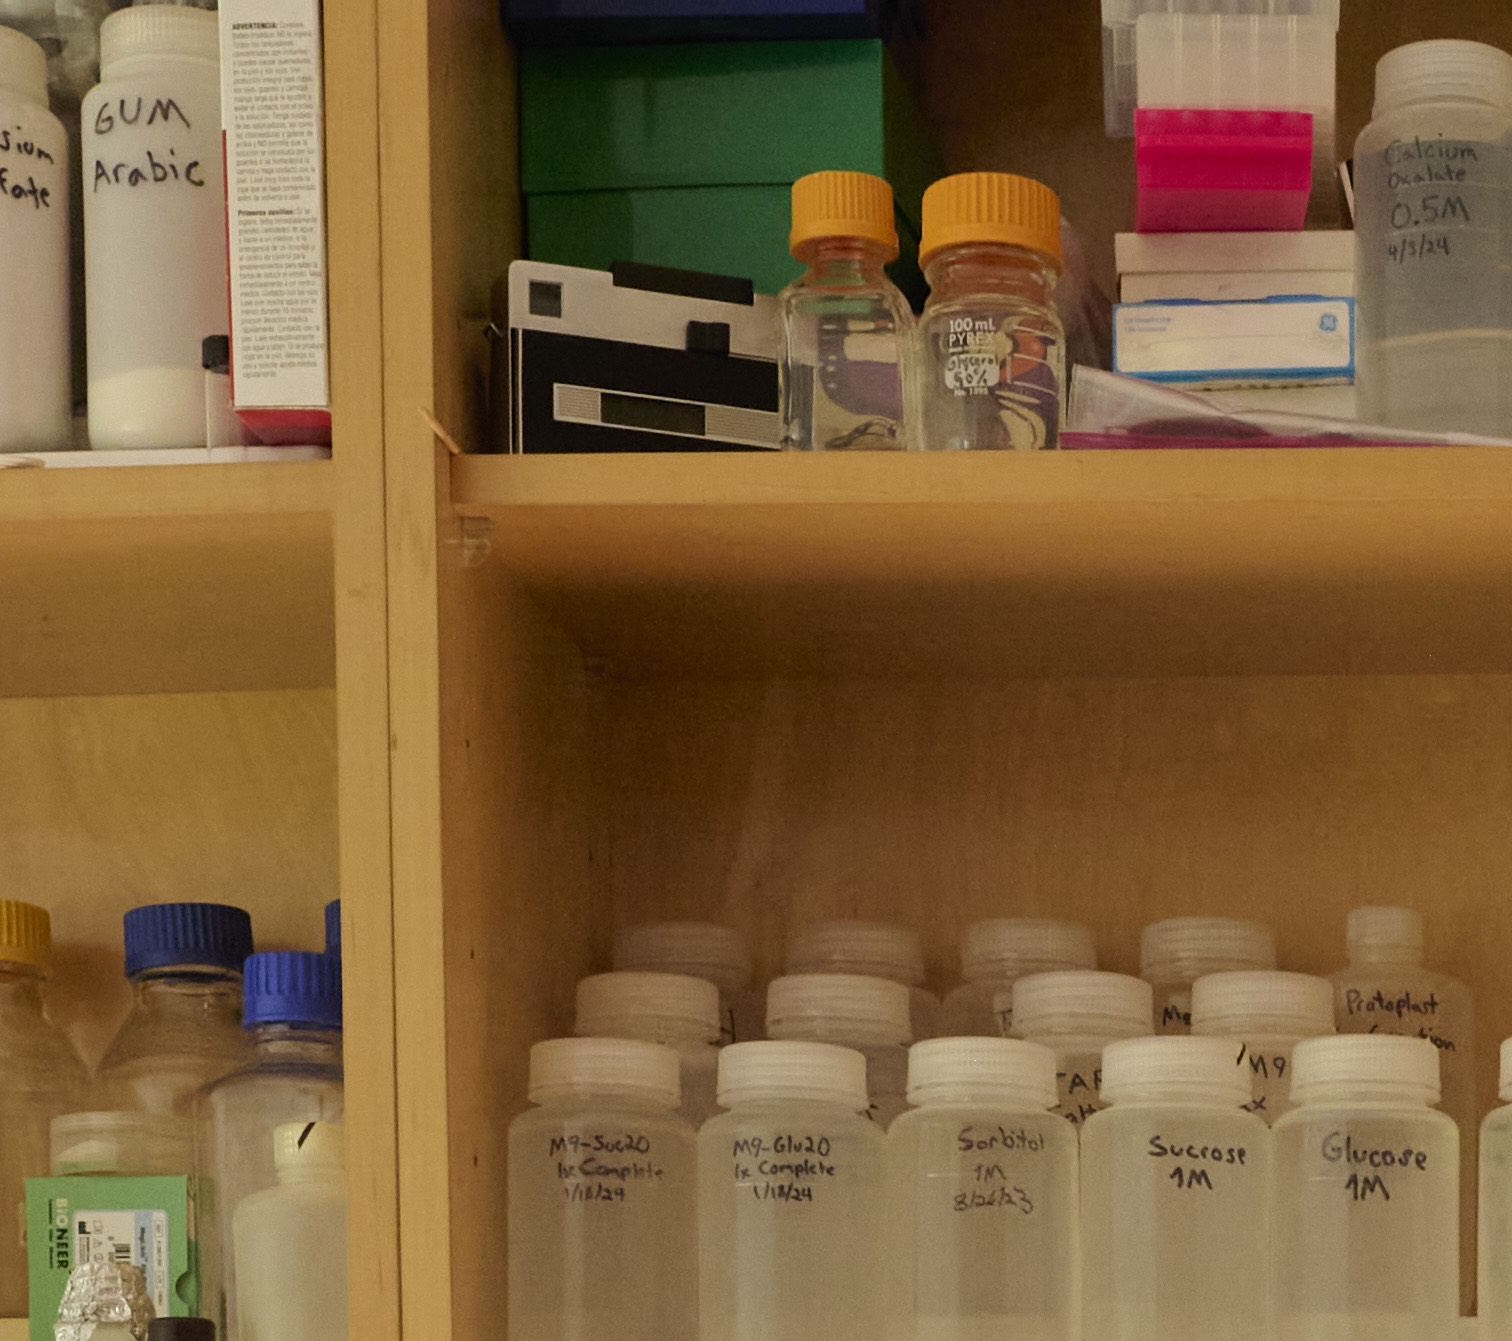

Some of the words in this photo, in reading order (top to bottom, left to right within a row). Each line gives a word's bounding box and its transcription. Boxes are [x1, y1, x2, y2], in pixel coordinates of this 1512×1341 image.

[94, 99, 191, 137] GUM
[1385, 134, 1478, 166] Calcium
[92, 151, 204, 192] Arabic
[1389, 165, 1466, 189] Oxalate
[1391, 196, 1470, 229] 0.5M
[949, 318, 972, 332] 100
[975, 318, 996, 330] mL
[949, 332, 995, 346] PYREX
[957, 1127, 1045, 1153] Sorbitol
[1149, 1136, 1247, 1166] Sucrose
[1321, 1132, 1427, 1171] Glucose
[975, 1165, 1006, 1181] 1M
[1170, 1166, 1212, 1190] 1M
[1346, 1174, 1390, 1200] 1M
